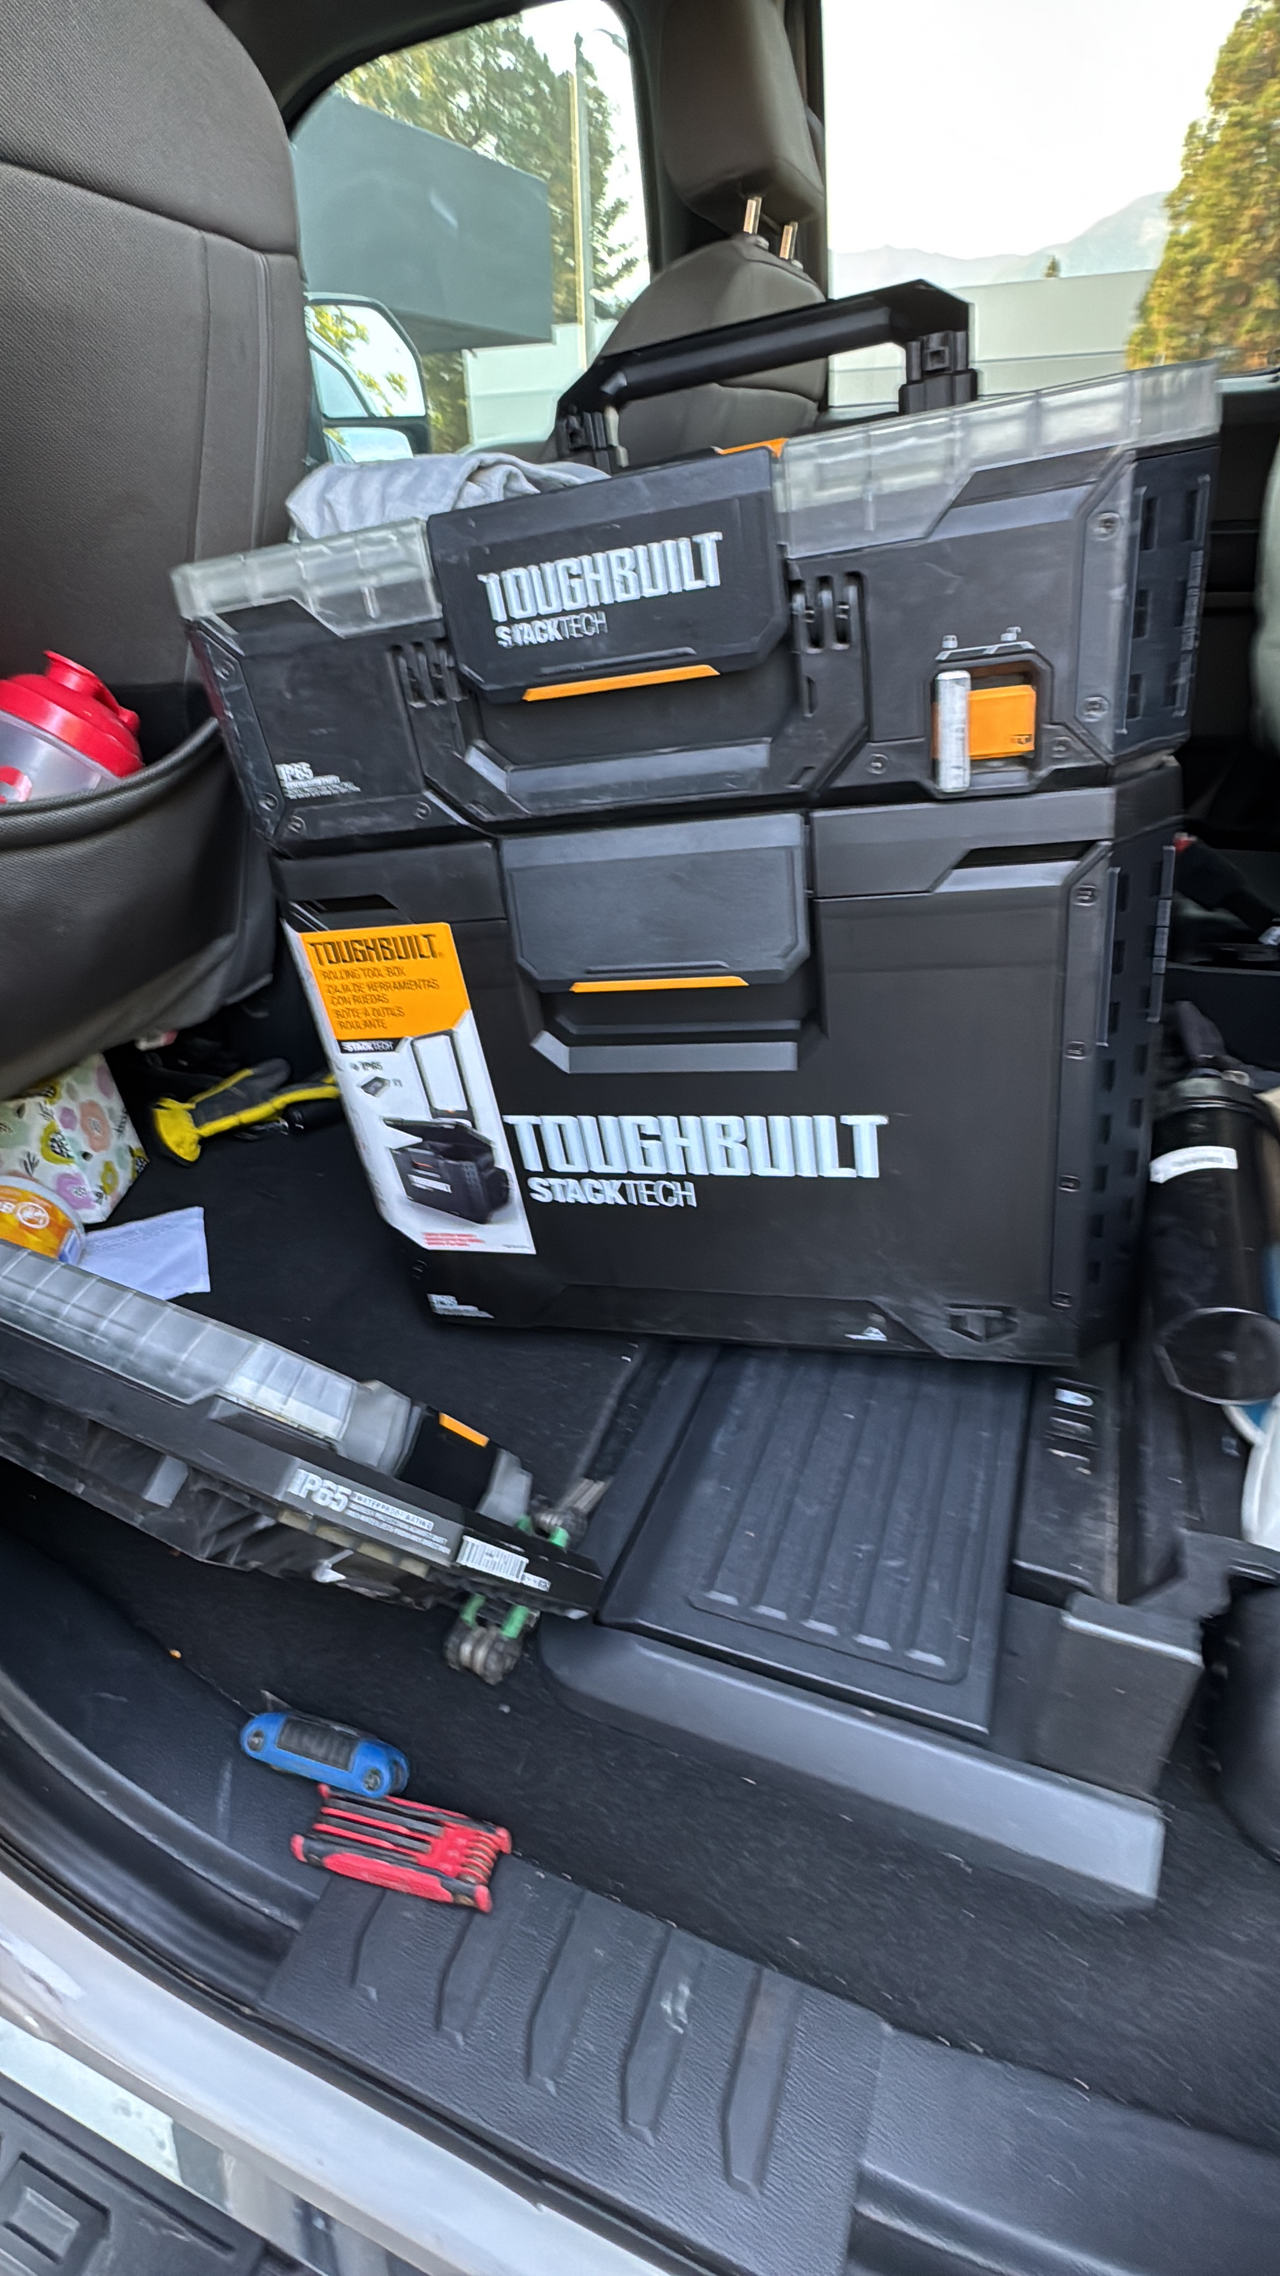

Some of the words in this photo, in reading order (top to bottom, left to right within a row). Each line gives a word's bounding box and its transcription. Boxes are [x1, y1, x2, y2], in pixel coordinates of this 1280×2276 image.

[477, 531, 723, 622] TOUGHBUILT
[495, 611, 609, 648] STACKTECH
[309, 935, 437, 965] TOUGHBUILT
[322, 969, 360, 980] ROLLING
[360, 967, 385, 978] TOOL
[386, 966, 406, 977] BOX
[367, 979, 440, 991] HERRAMIENTAS
[330, 995, 352, 1006] CON
[352, 993, 390, 1005] RUEDAS
[502, 1115, 889, 1178] TOUGHBUILT
[528, 1177, 698, 1207] STACKTECH
[287, 1468, 353, 1513] IP65
